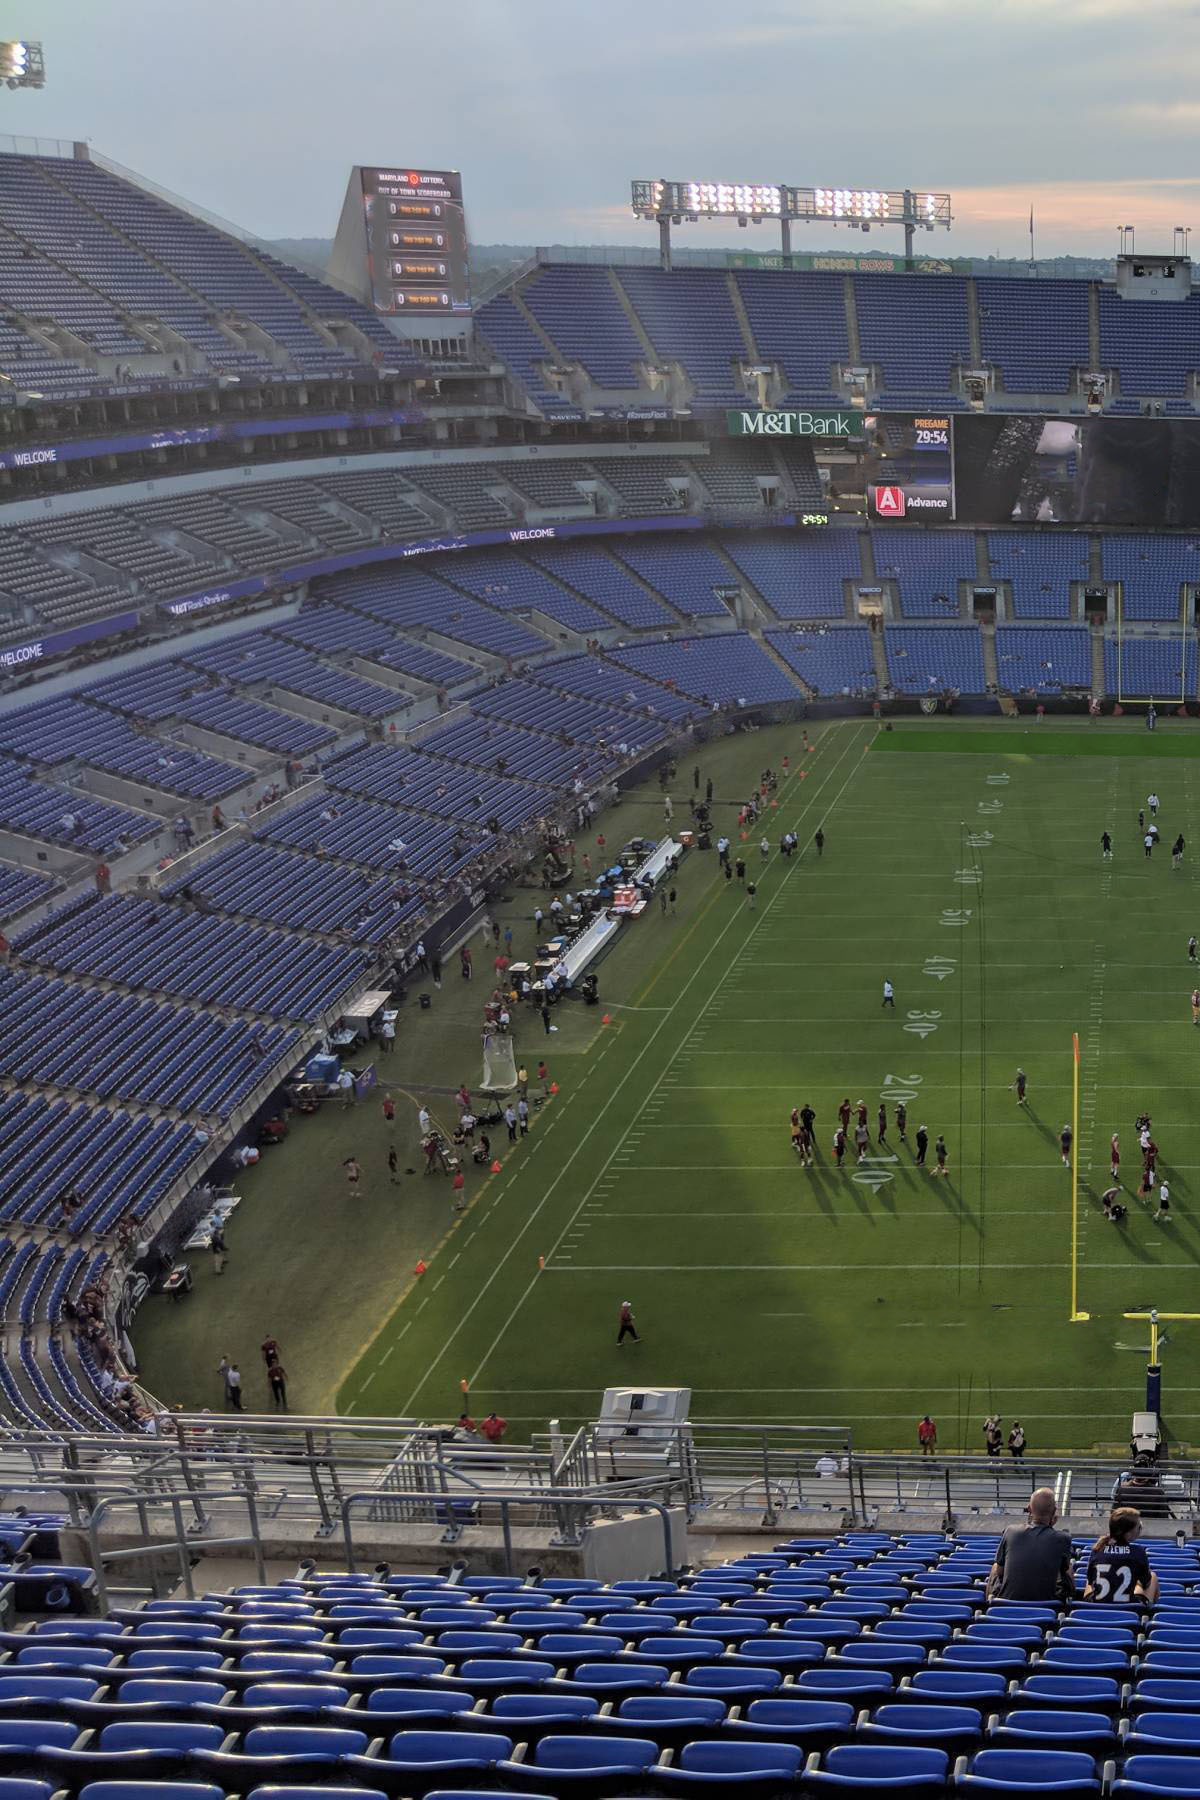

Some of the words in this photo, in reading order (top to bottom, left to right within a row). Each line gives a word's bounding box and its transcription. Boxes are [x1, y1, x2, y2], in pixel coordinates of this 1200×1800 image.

[378, 174, 408, 182] MARYLAND
[390, 204, 397, 214] 0
[434, 205, 441, 216] 0
[393, 234, 399, 244] 0
[437, 235, 443, 245] 0
[395, 264, 402, 274] 0
[440, 265, 445, 275] 0
[398, 294, 404, 304] 0
[443, 294, 448, 304] 0
[742, 412, 796, 434] M&T
[799, 413, 850, 435] Bank
[915, 418, 949, 429] PREGAME
[917, 430, 948, 444] 29:54
[14, 450, 57, 466] WELCOME
[907, 496, 947, 508] Advance
[802, 514, 829, 525] 29:54
[510, 528, 555, 541] WELCOME
[0, 643, 43, 667] WELCOME
[922, 955, 958, 976] 40
[903, 1009, 942, 1033] 30
[880, 1074, 923, 1101] 20
[851, 1154, 899, 1184] 10
[1095, 1564, 1132, 1602] 52
